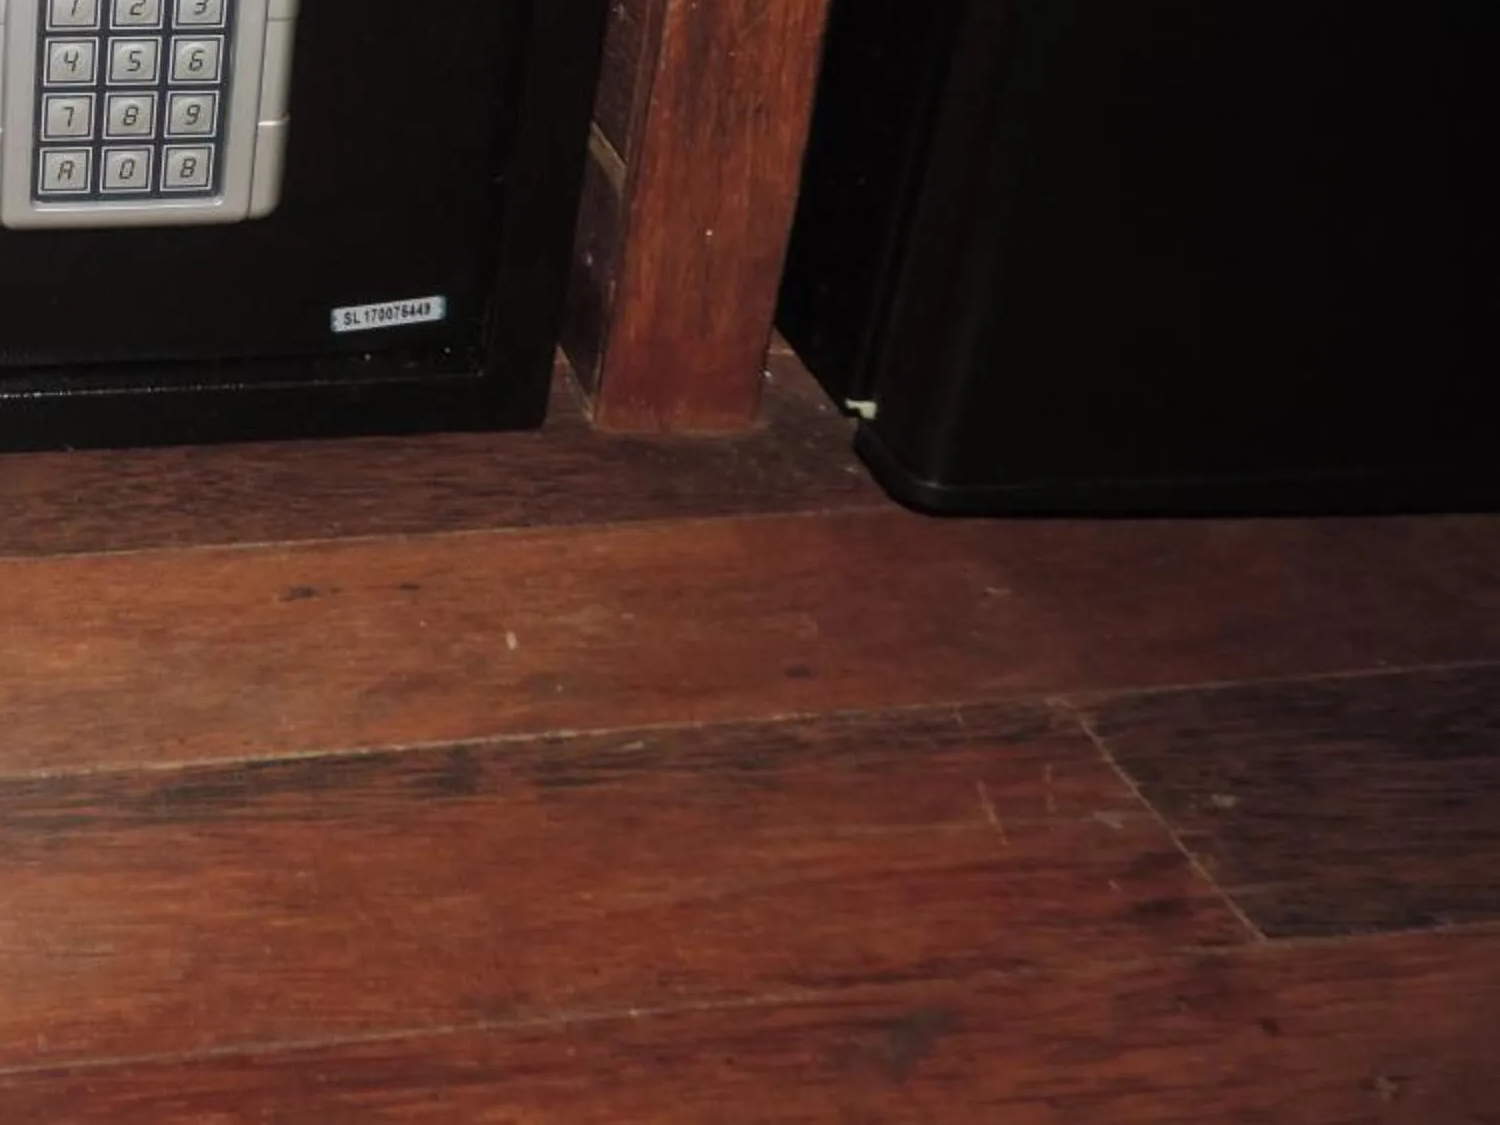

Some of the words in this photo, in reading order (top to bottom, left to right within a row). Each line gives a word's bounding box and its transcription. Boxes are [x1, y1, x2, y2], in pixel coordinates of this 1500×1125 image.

[63, 50, 80, 73] 4
[127, 50, 142, 72] 5
[188, 49, 205, 71] 6
[62, 106, 75, 128] 7
[122, 105, 139, 126] 8
[185, 103, 202, 125] 9
[57, 159, 75, 182] A
[343, 311, 360, 325] SL
